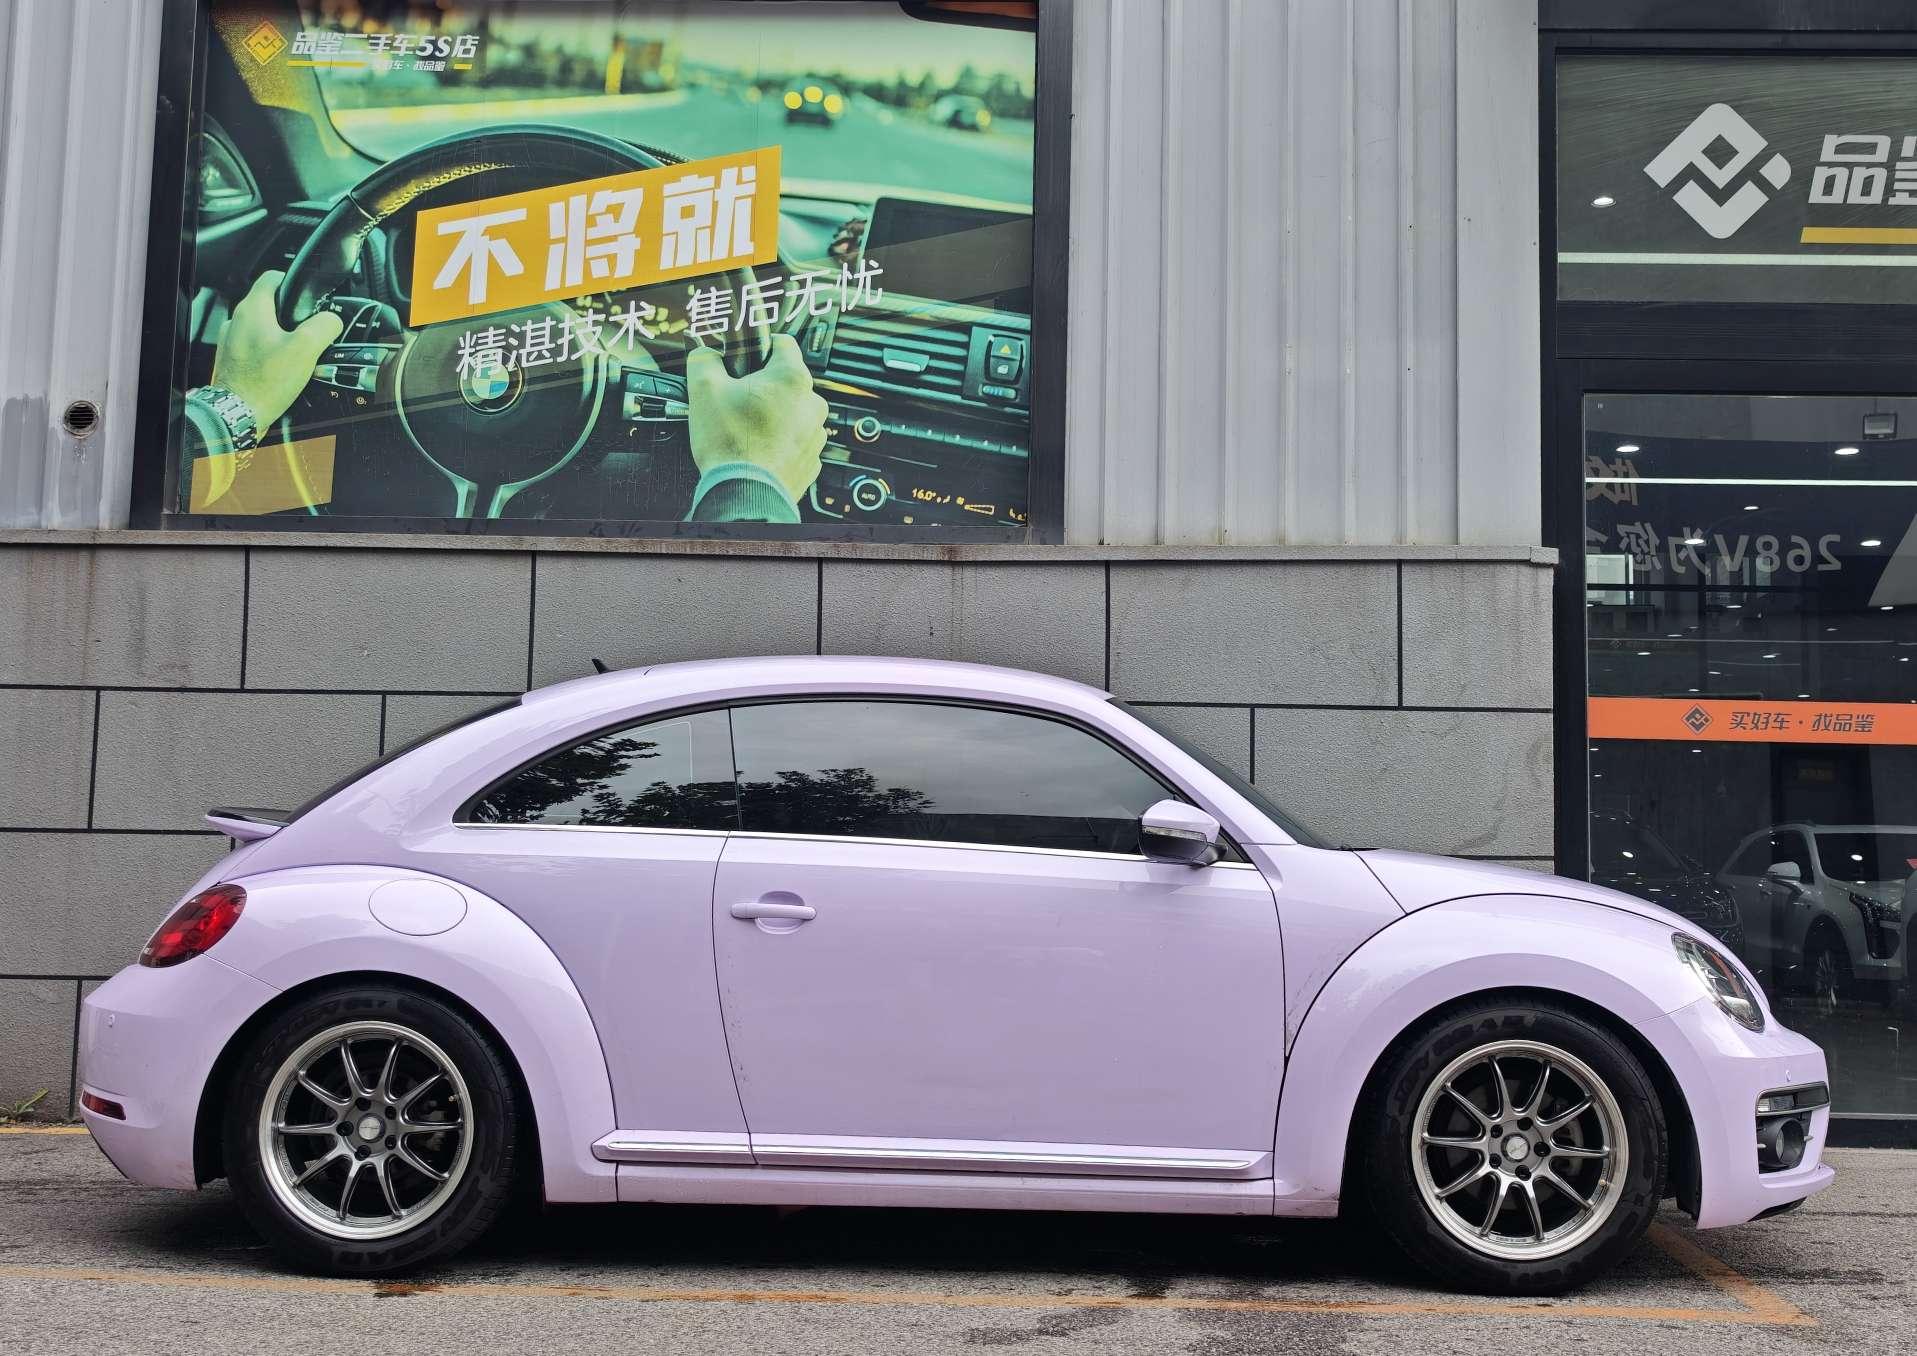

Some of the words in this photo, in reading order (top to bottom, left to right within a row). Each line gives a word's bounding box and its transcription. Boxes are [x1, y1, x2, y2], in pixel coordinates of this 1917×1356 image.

[292, 31, 480, 58] 品鉴二手车5S店
[433, 166, 757, 305] 不将就
[455, 300, 656, 381] 精湛技术
[686, 259, 884, 337] 售后无忧
